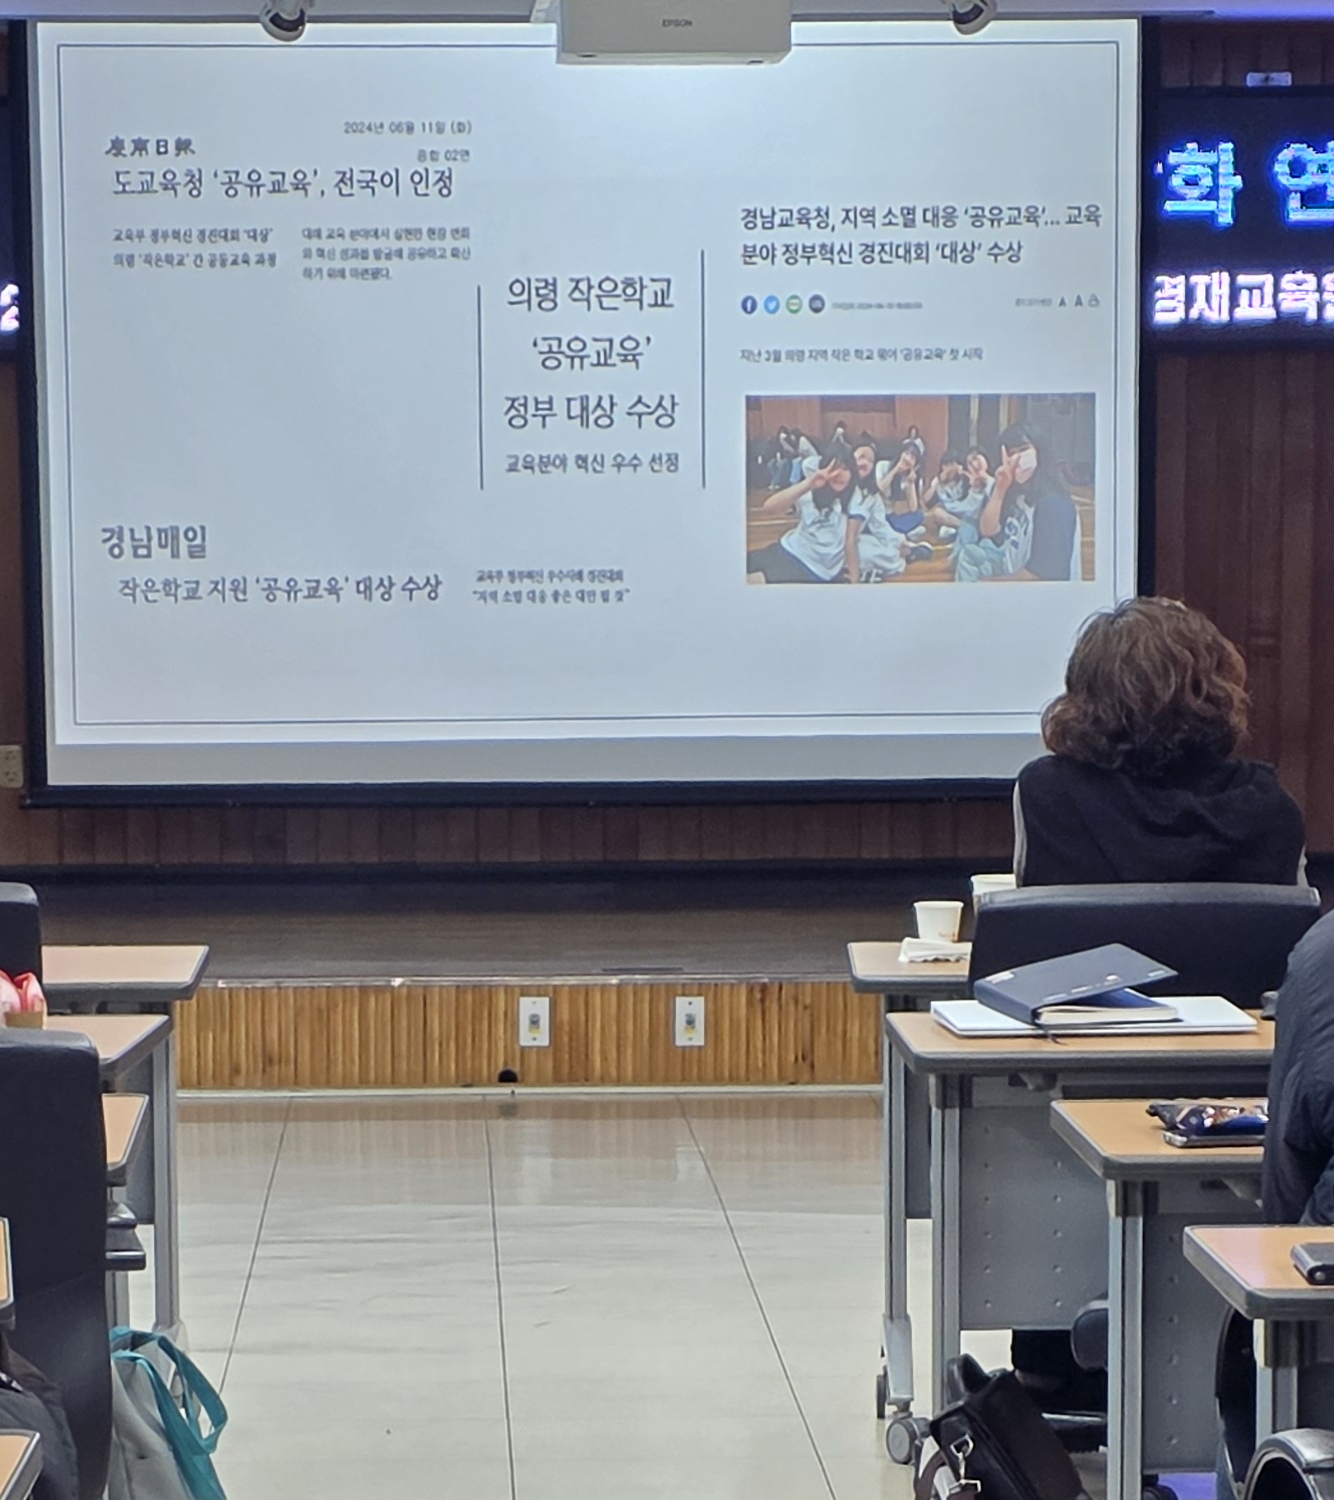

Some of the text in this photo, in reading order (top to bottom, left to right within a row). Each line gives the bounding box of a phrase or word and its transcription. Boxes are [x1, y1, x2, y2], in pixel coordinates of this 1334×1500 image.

[344, 121, 384, 135] 2024년
[112, 167, 203, 198] 도교육청
[333, 167, 400, 198] 전국이
[409, 166, 452, 198] 인정
[841, 205, 876, 230] 지역
[881, 205, 917, 229] 소멸
[922, 205, 959, 229] 대응
[1064, 204, 1102, 228] 교육
[740, 242, 778, 267] 분야
[781, 241, 853, 266] 정부혁신
[858, 240, 929, 265] 경진대회
[987, 240, 1024, 264] 수상
[505, 275, 675, 313] 의령 작은학교
[503, 393, 680, 430] 정부 대상 수상
[505, 452, 679, 475] 교육분야 혁신 우수 선정
[101, 524, 207, 560] 경남매일
[118, 577, 203, 605] 작은학교
[207, 576, 248, 604] 지원
[355, 575, 396, 603] 대상
[400, 574, 443, 602] 수상
